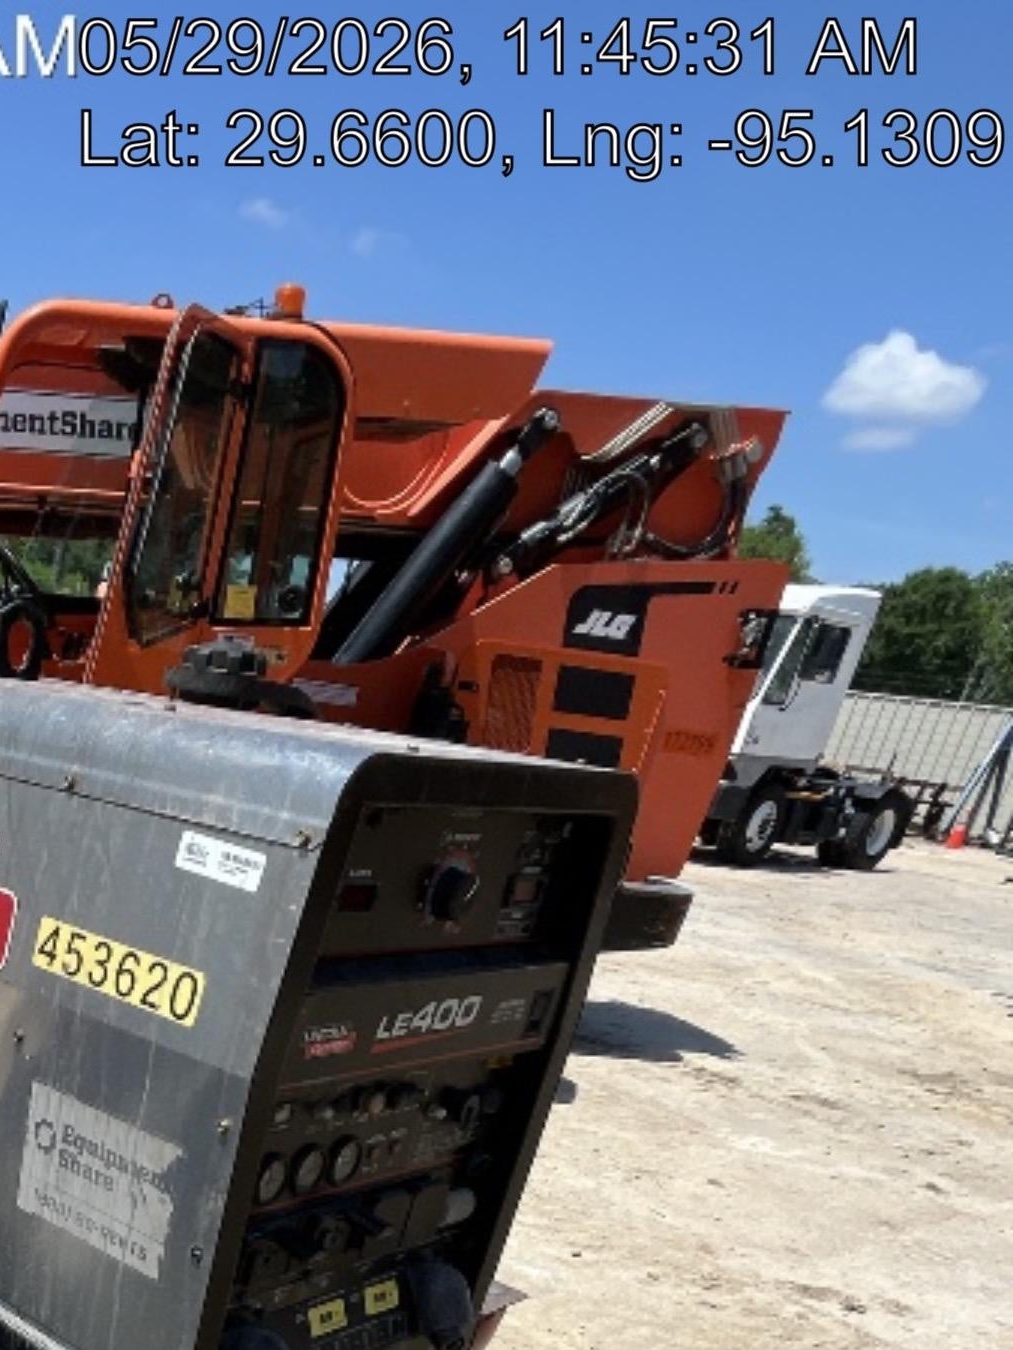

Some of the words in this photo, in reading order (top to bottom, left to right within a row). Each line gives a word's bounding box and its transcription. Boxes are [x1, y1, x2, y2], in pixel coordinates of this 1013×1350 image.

[572, 608, 639, 640] JLG
[37, 926, 200, 1021] 453620
[376, 995, 483, 1039] LE400
[58, 1148, 115, 1192] Share
